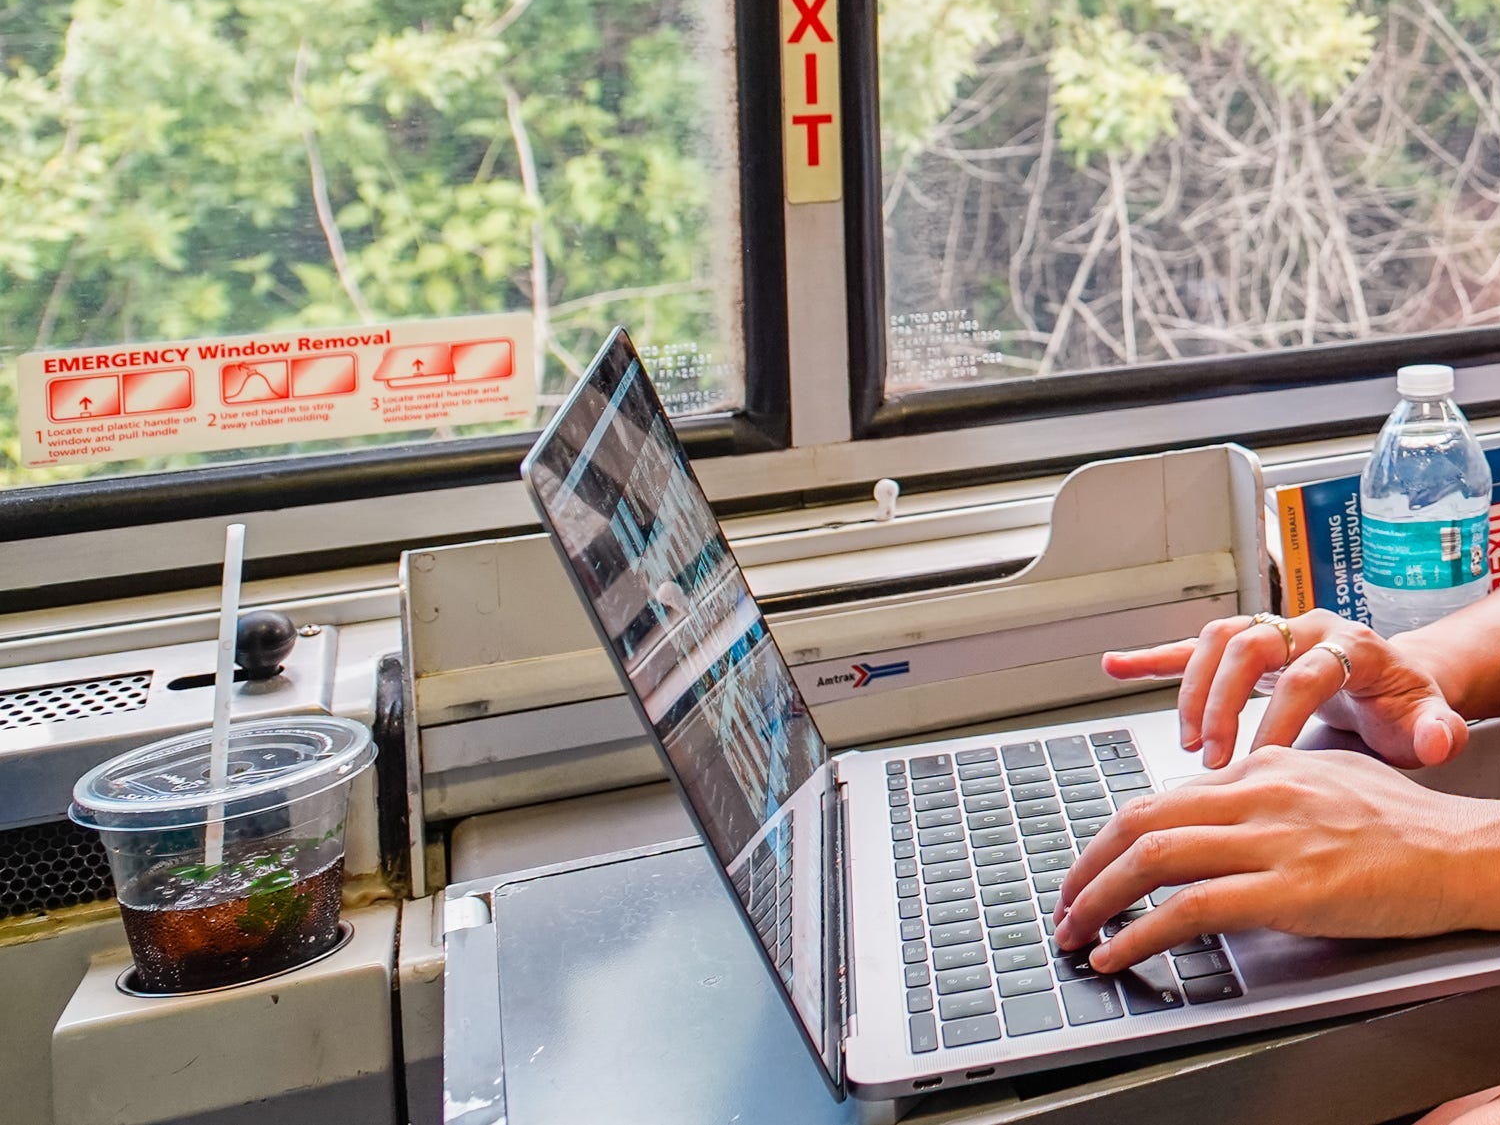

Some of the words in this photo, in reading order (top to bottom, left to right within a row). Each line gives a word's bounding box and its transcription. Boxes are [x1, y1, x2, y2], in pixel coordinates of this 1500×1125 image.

[44, 347, 190, 373] EMERGENCY
[197, 341, 291, 360] Window
[297, 329, 391, 351] Removal
[370, 397, 380, 410] 3
[382, 394, 414, 404] Locate
[417, 391, 443, 400] metal
[446, 388, 479, 397] handle
[482, 385, 499, 394] and
[220, 411, 239, 420] Use
[241, 408, 259, 418] red
[261, 405, 296, 416] handle
[299, 404, 310, 412] to
[312, 401, 335, 412] strip
[383, 404, 402, 415] pull
[404, 401, 439, 411] toward
[441, 399, 459, 409] you
[461, 397, 472, 405] to
[474, 394, 510, 404] remove
[47, 427, 83, 437] Locate
[86, 423, 104, 433] red
[107, 419, 141, 433] plastic
[144, 416, 181, 427] handle
[183, 416, 197, 424] on
[207, 413, 217, 427] 2
[220, 421, 248, 430] away
[250, 416, 284, 427] rubber
[384, 412, 422, 423] window
[35, 430, 43, 444] 1
[48, 436, 92, 447] window
[95, 432, 115, 443] and
[118, 430, 139, 442] pull
[141, 426, 178, 438] handle
[49, 445, 88, 458] toward
[91, 445, 114, 456] you.
[1287, 506, 1300, 551] LITERALLY
[1344, 492, 1364, 569] UNUSUAL,
[1328, 514, 1351, 606] SOMETHING
[1353, 573, 1365, 594] OR
[817, 673, 855, 687] Amtrak
